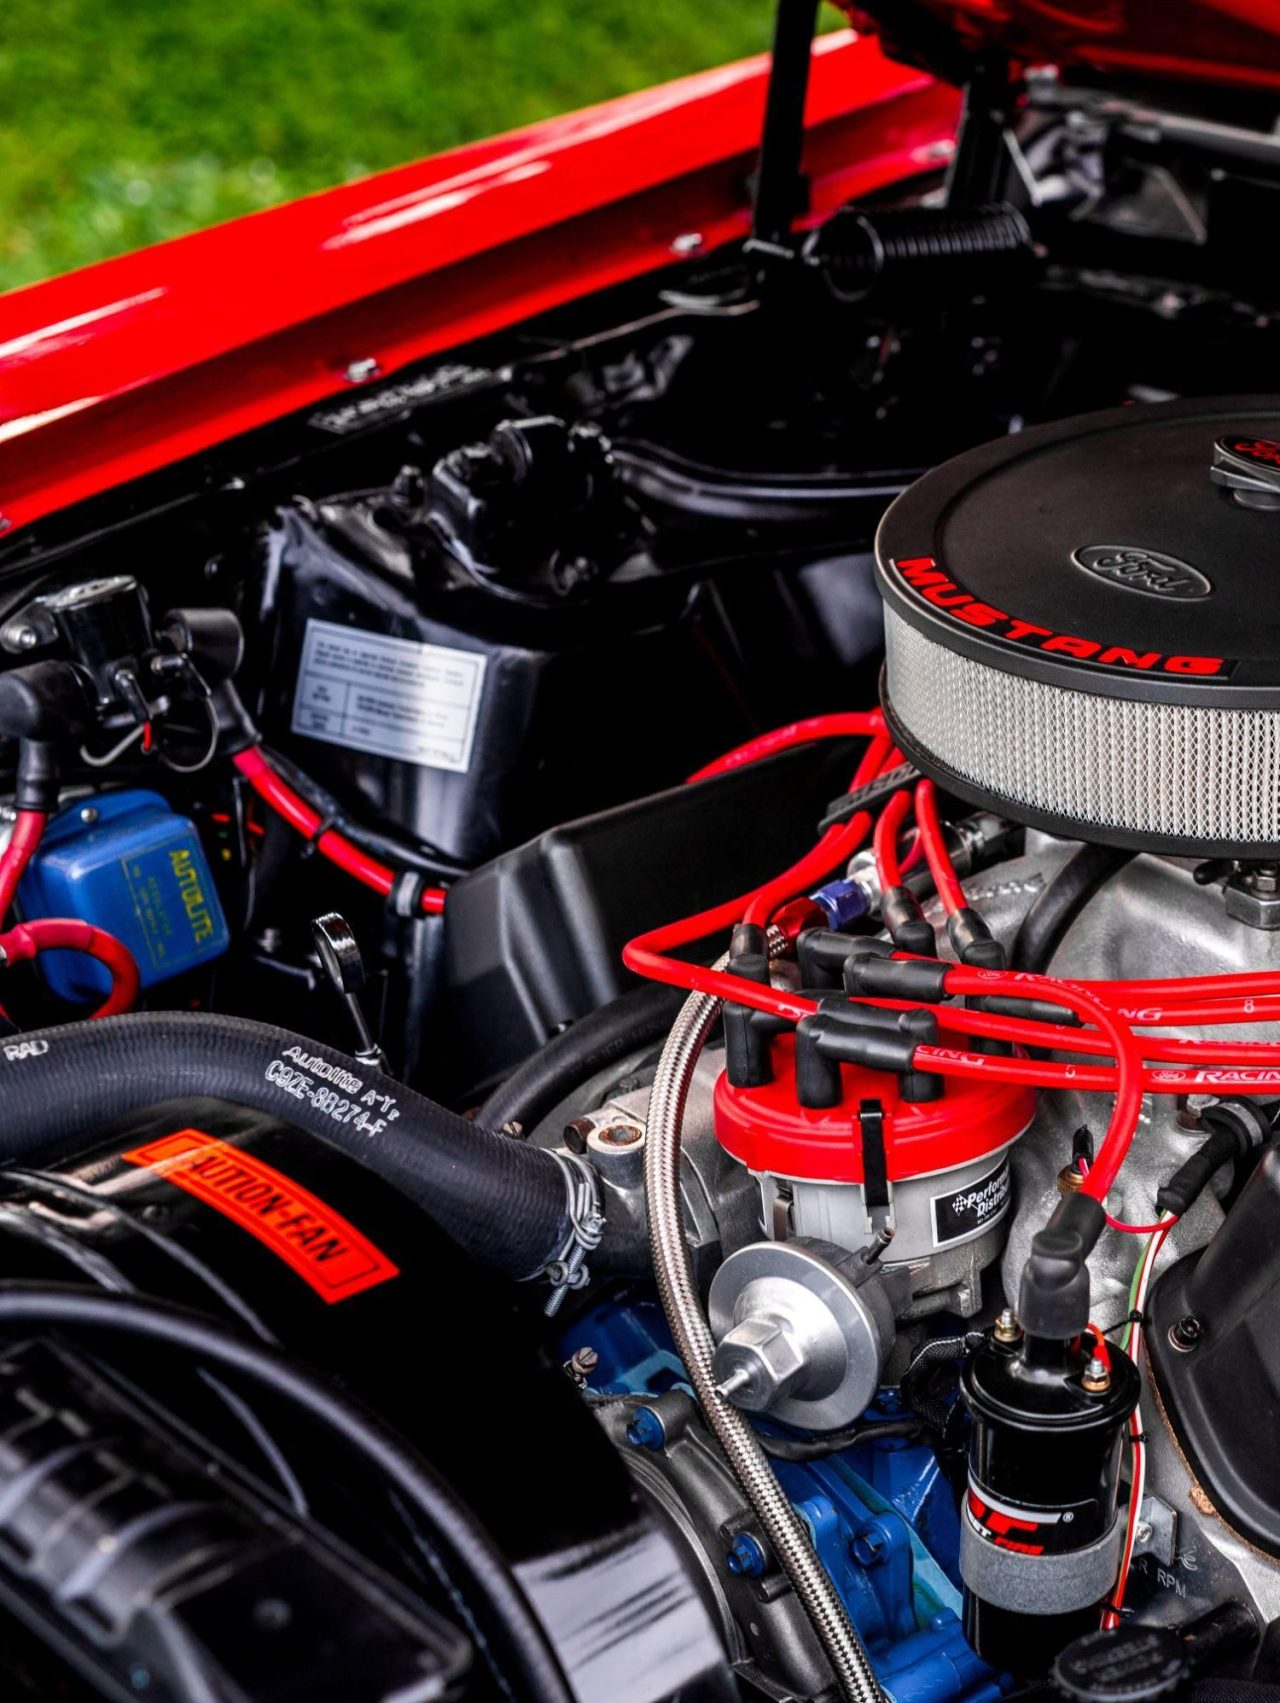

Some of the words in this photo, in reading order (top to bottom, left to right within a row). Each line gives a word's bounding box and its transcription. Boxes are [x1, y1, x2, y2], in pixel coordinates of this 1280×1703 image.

[1093, 552, 1190, 592] Ford
[896, 557, 1224, 676] MUSTANG
[168, 849, 213, 945] AUTOLITE
[1243, 1000, 1254, 1014] 8
[3, 1040, 49, 1061] RAD
[281, 1046, 364, 1095] Autolite
[1155, 1071, 1184, 1082] Ford
[182, 1150, 348, 1262] AUTION-FAN
[1157, 1567, 1186, 1599] RPM
